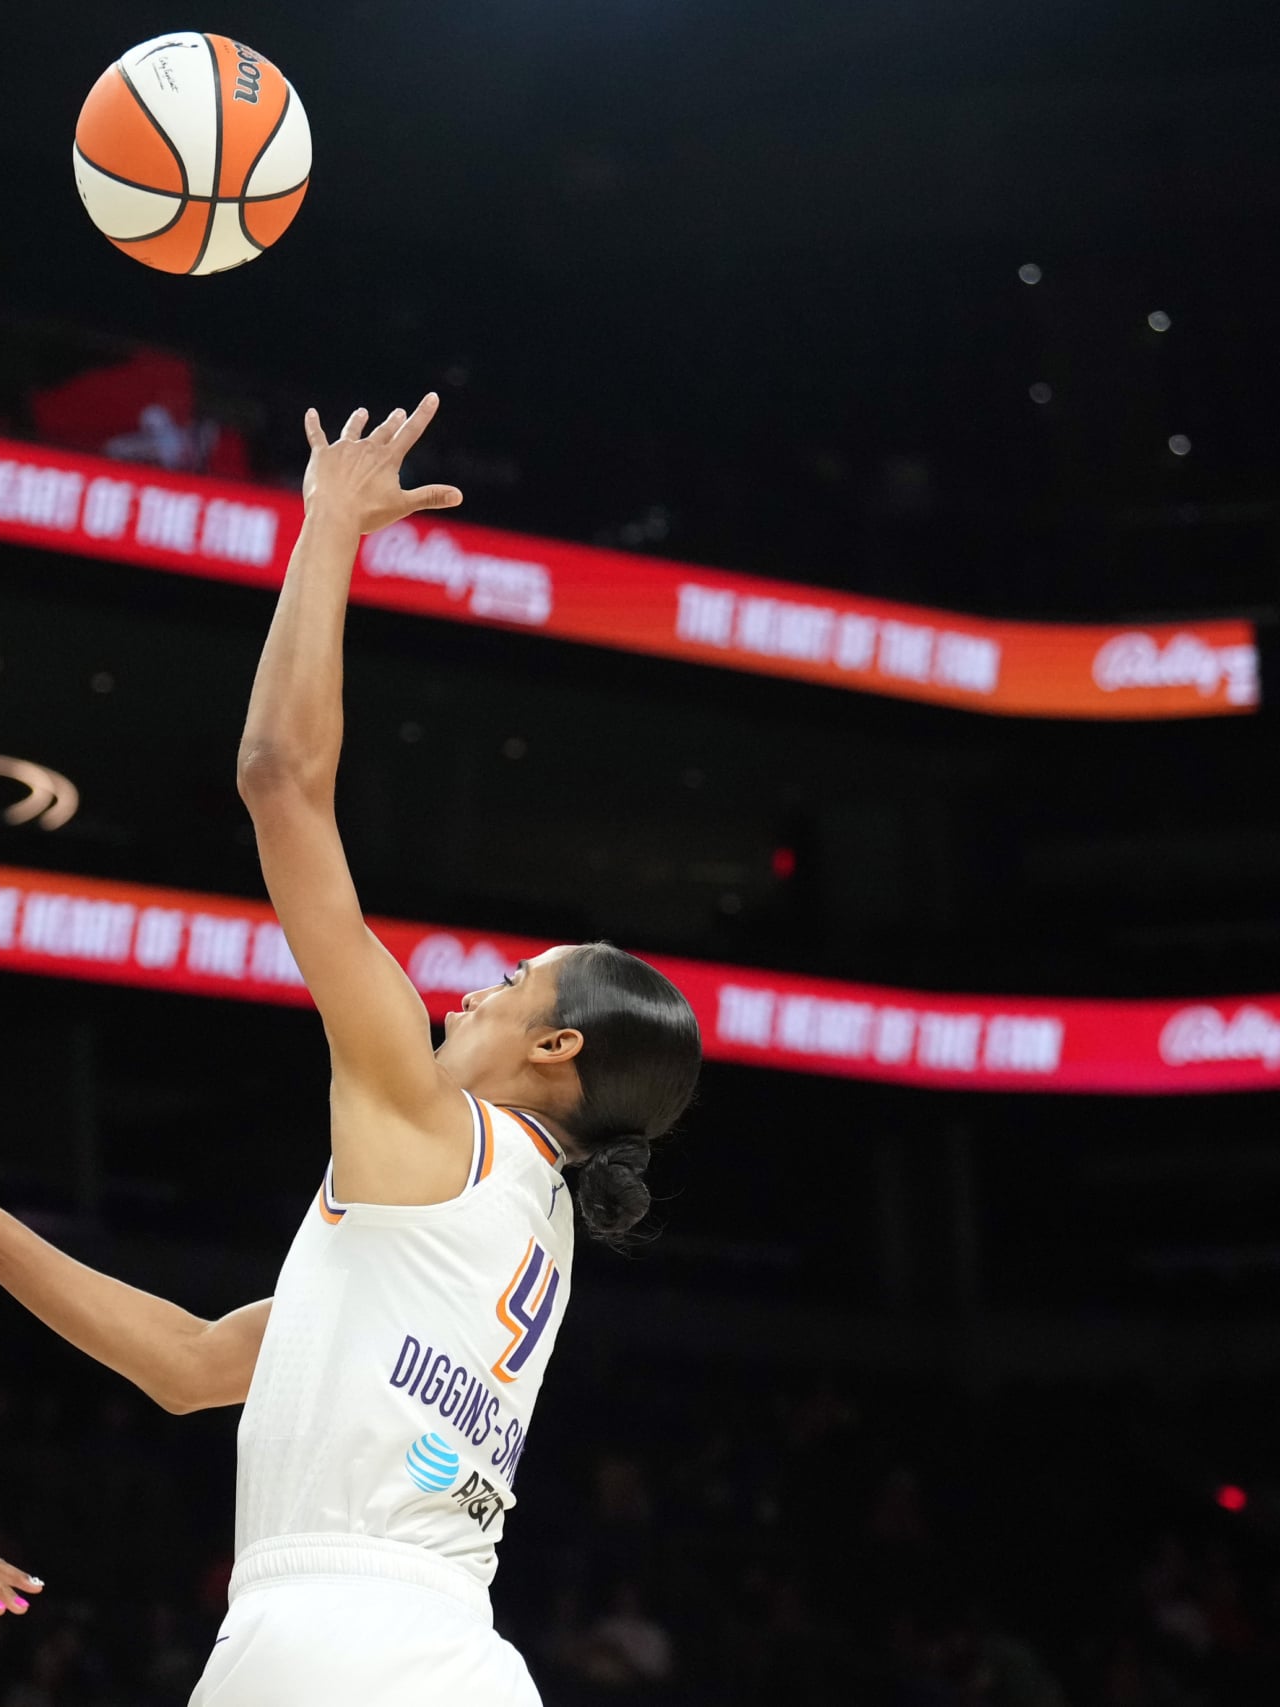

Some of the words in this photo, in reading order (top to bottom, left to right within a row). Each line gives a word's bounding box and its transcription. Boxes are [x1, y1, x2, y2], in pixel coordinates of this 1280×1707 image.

[233, 40, 266, 104] son
[82, 476, 133, 540] OF
[135, 486, 202, 554] THE
[200, 499, 278, 566] FAN
[676, 583, 736, 649] THE
[735, 595, 836, 664] HEART
[833, 612, 878, 672] OF
[877, 618, 936, 685] THE
[934, 631, 1001, 696] FAN
[21, 891, 136, 964] HEART
[133, 906, 185, 970] OF
[186, 913, 251, 980] THE
[249, 922, 308, 986] FA
[717, 984, 776, 1049] THE
[776, 994, 876, 1060] HEART
[873, 1005, 918, 1064] OF
[918, 1011, 984, 1073] THE
[984, 1014, 1064, 1075] FAN
[490, 1235, 560, 1383] 4
[389, 1334, 526, 1492] DIGGINS-SM
[451, 1470, 504, 1533] AT&T
